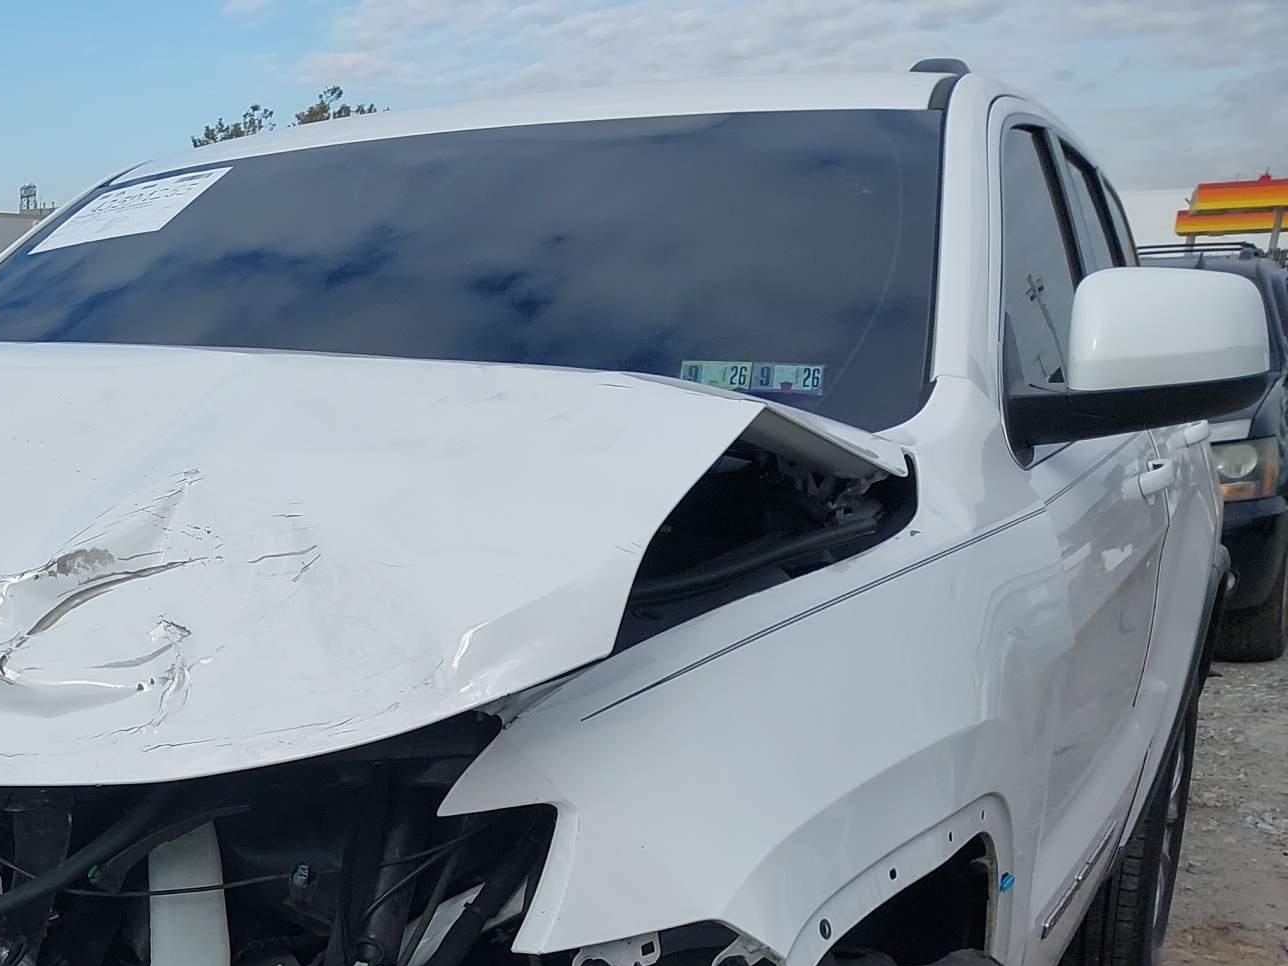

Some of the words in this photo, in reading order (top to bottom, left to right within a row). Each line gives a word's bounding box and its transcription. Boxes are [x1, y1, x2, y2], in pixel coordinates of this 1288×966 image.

[729, 366, 748, 386] 26
[759, 366, 771, 387] 9
[802, 368, 821, 388] 26
